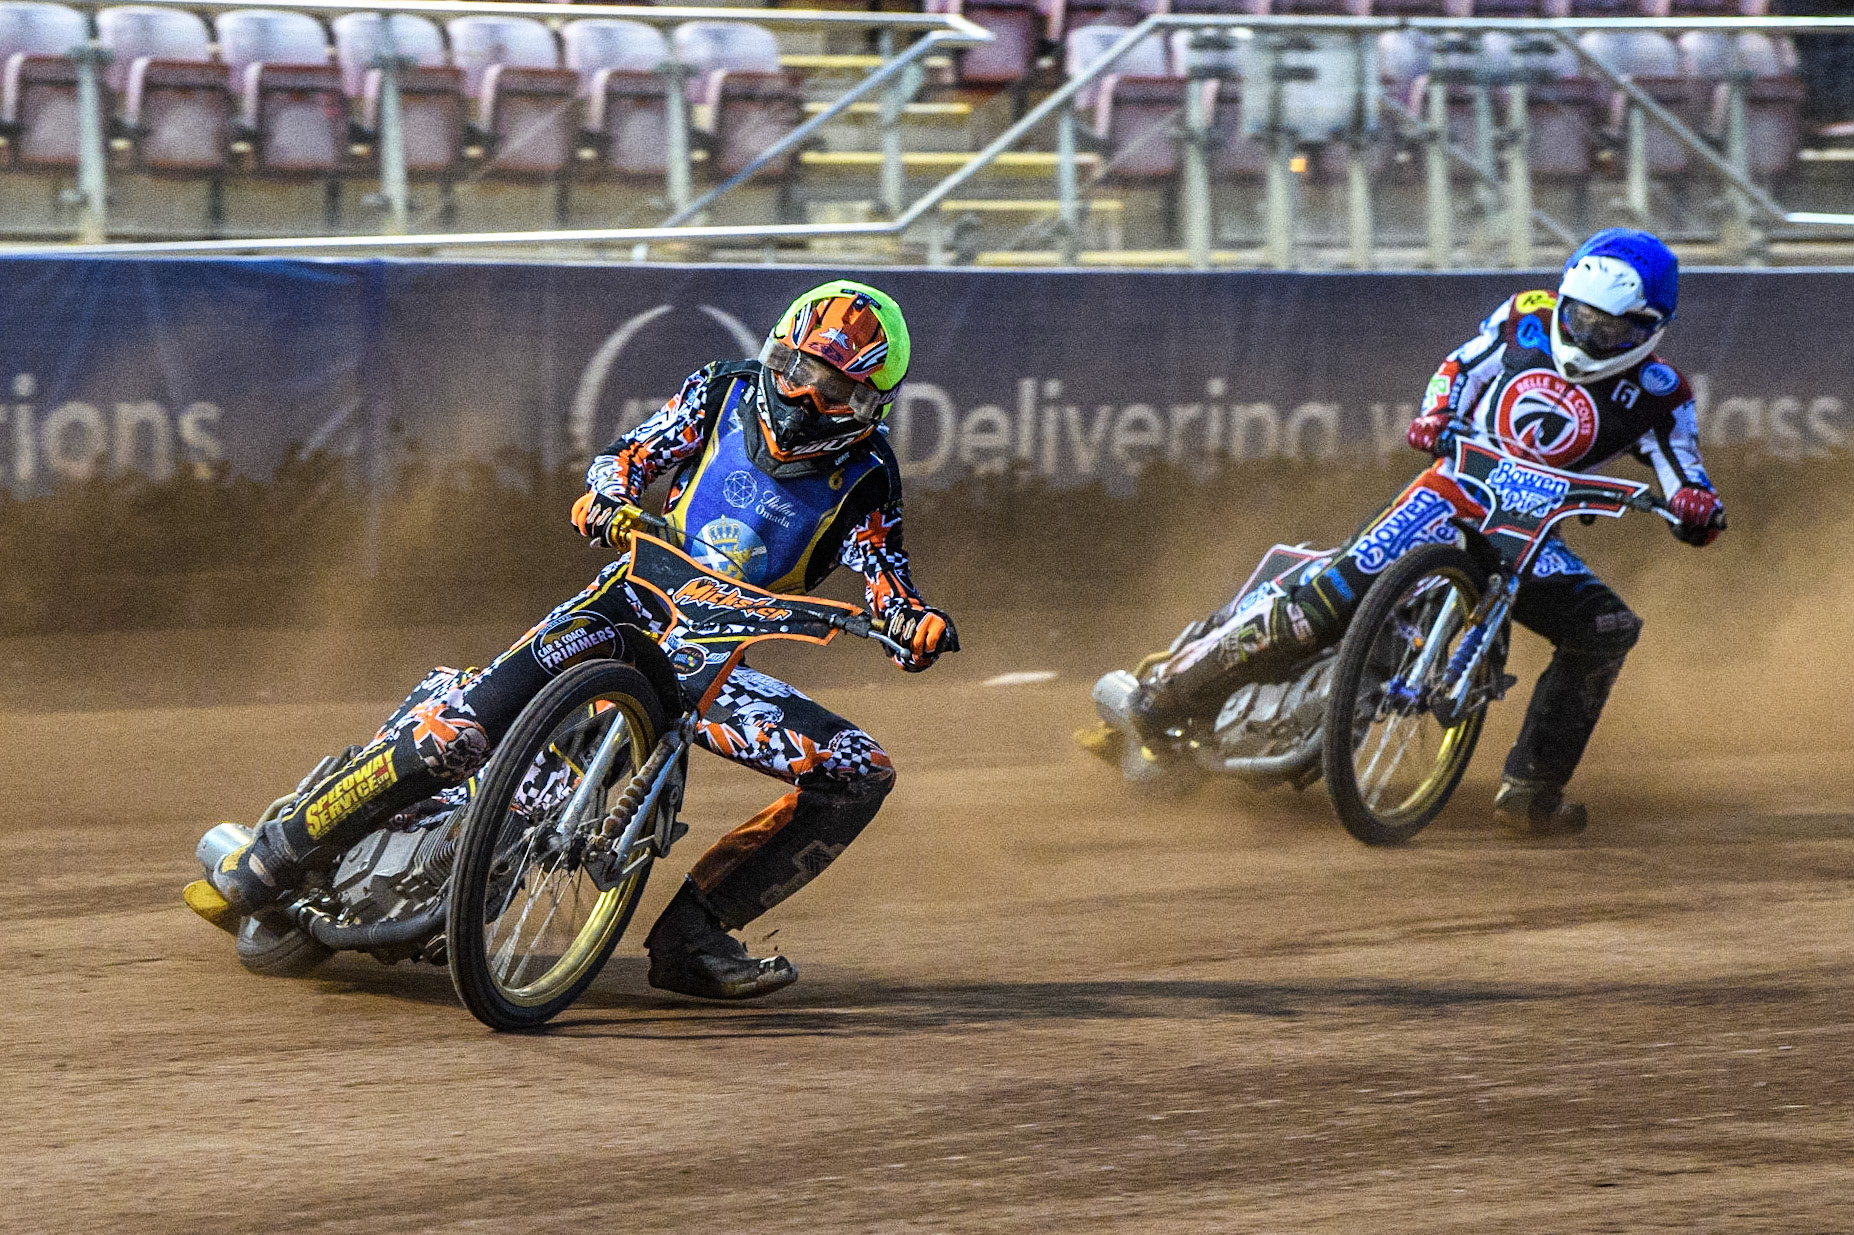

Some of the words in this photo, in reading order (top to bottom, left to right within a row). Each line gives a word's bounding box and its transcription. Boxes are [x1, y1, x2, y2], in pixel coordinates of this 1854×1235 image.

[0, 373, 229, 480] ions
[1692, 374, 1845, 461] lass
[1491, 461, 1567, 494] Bowen
[1357, 490, 1438, 569] Bowen
[537, 643, 555, 658] CAR
[553, 640, 563, 649] &
[560, 627, 588, 644] COACH
[541, 626, 616, 669] TRIMMERS
